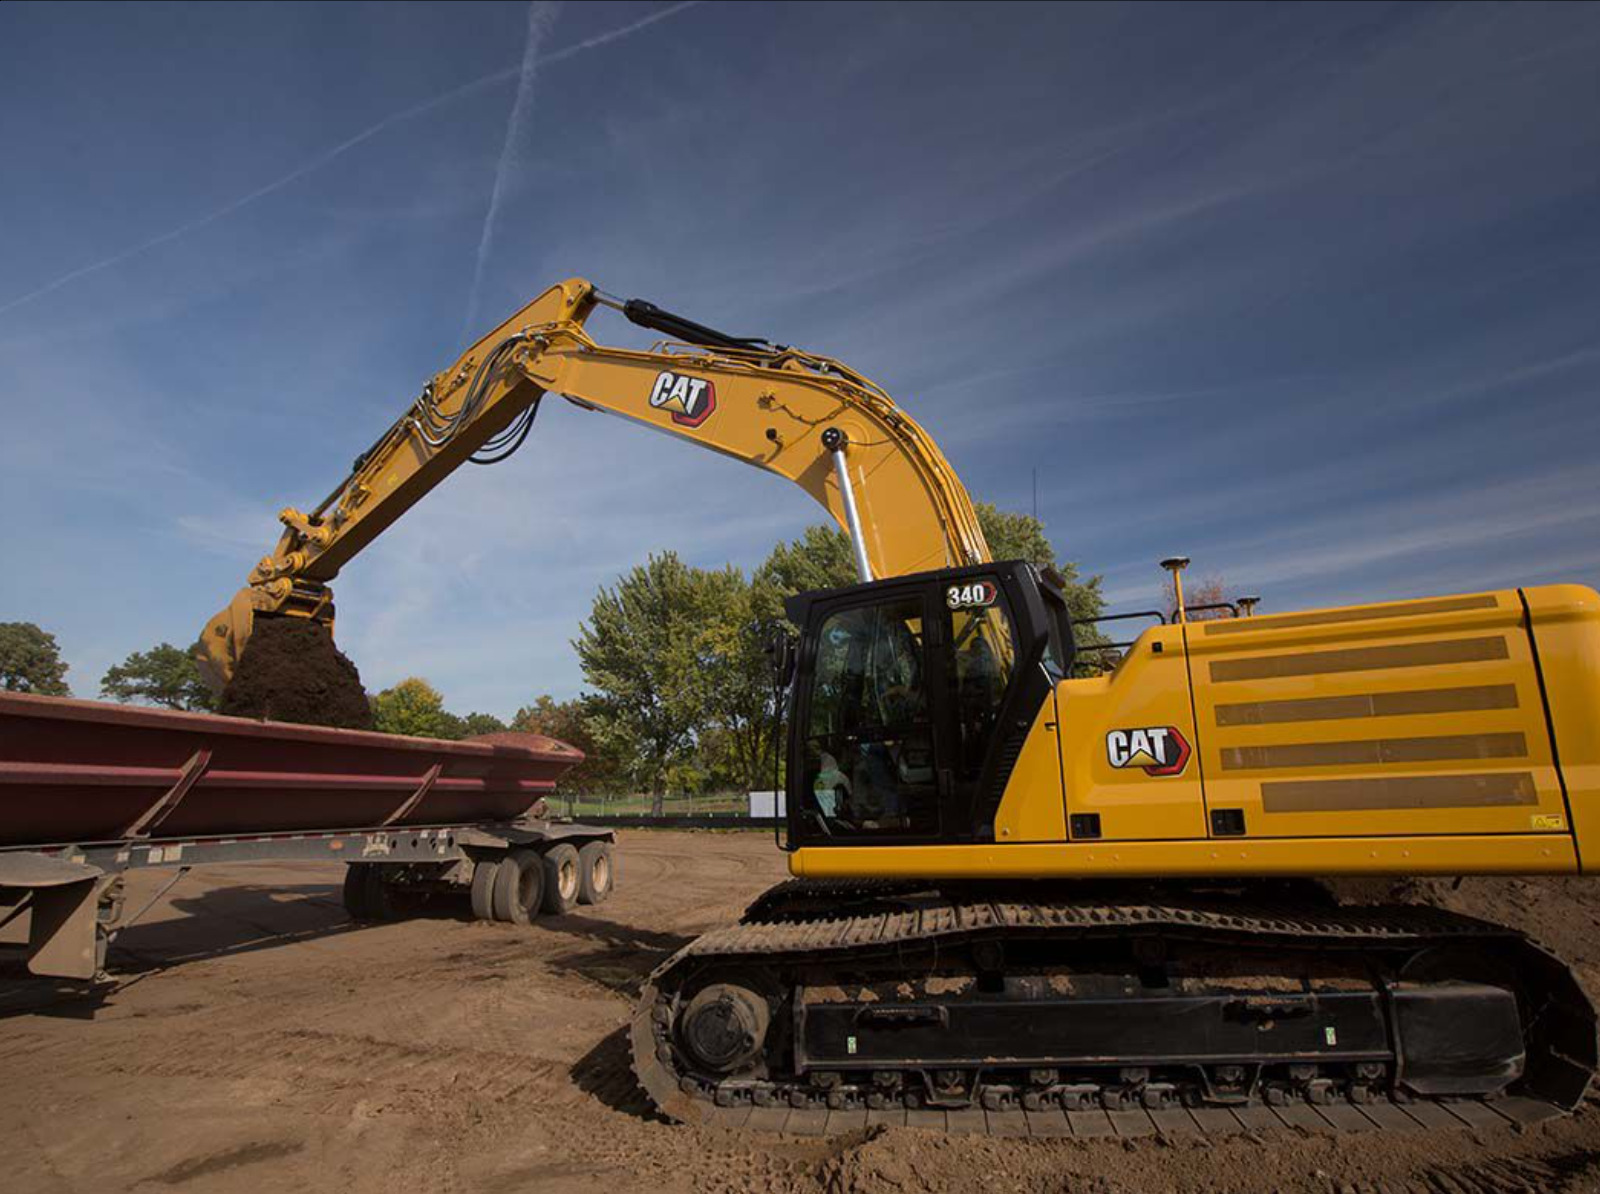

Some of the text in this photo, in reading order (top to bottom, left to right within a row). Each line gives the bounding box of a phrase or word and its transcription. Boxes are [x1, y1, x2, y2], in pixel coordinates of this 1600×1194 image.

[650, 372, 707, 414] CAT
[949, 584, 985, 605] 340
[1107, 728, 1168, 767] CAT
